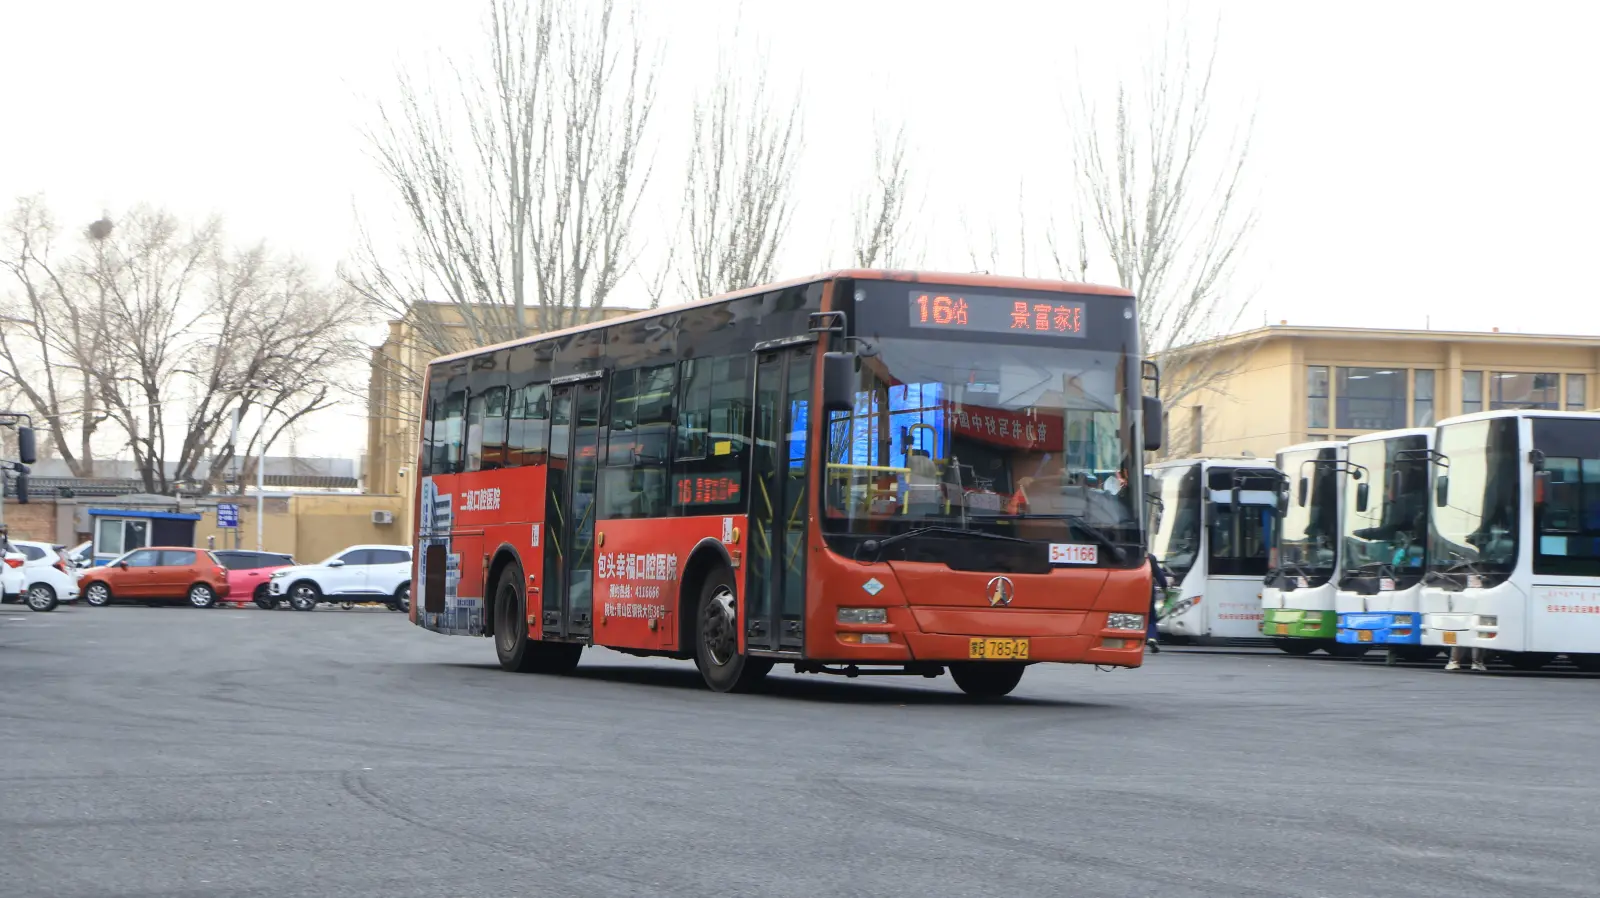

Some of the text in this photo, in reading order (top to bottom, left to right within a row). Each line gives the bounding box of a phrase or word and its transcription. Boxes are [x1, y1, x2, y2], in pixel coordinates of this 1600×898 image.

[460, 487, 500, 511] 二级口腔医院
[1052, 546, 1095, 561] 5-1166
[598, 552, 677, 580] 包头幸福口腔医院
[989, 641, 1028, 657] 78542
